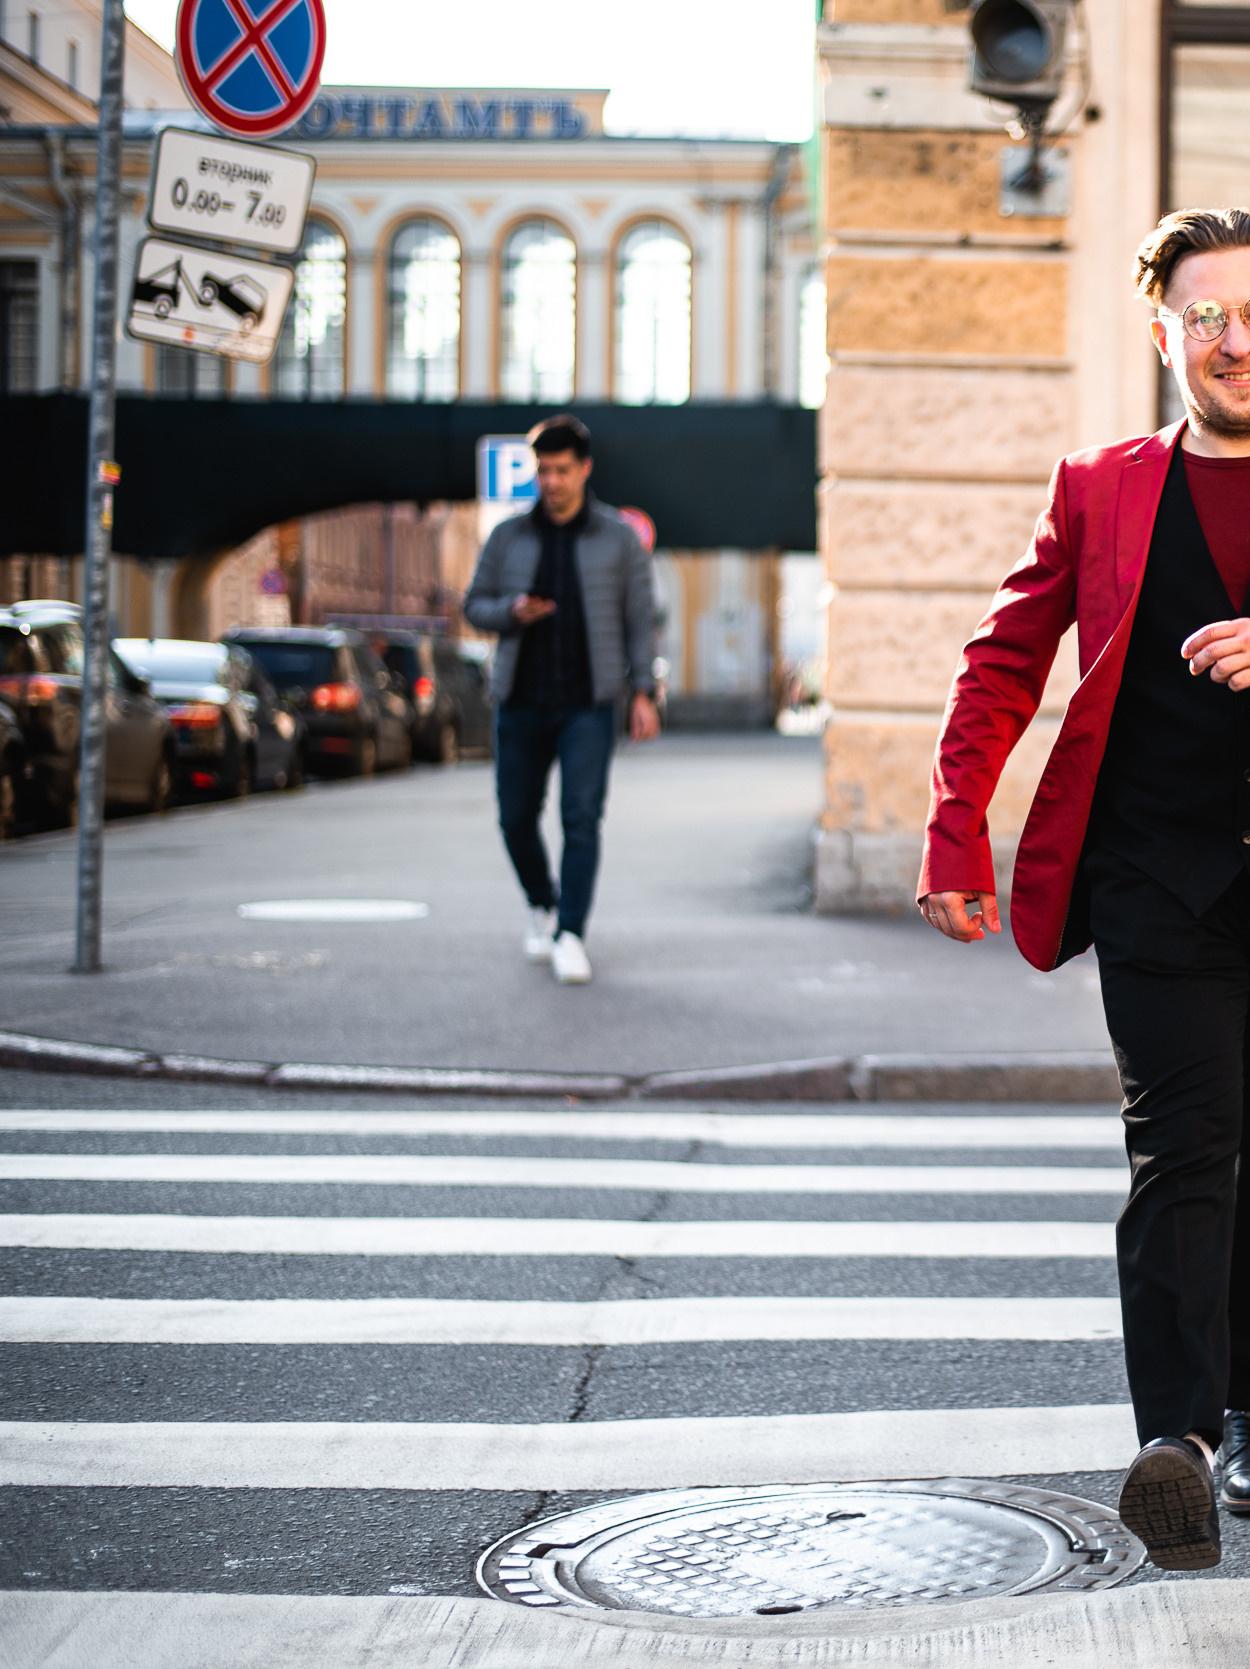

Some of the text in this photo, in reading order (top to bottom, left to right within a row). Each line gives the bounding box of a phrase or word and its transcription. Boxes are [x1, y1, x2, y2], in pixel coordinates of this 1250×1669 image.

[290, 92, 592, 139] ОЧТАМТЪ
[199, 157, 272, 187] вторник
[246, 191, 287, 228] 7.00
